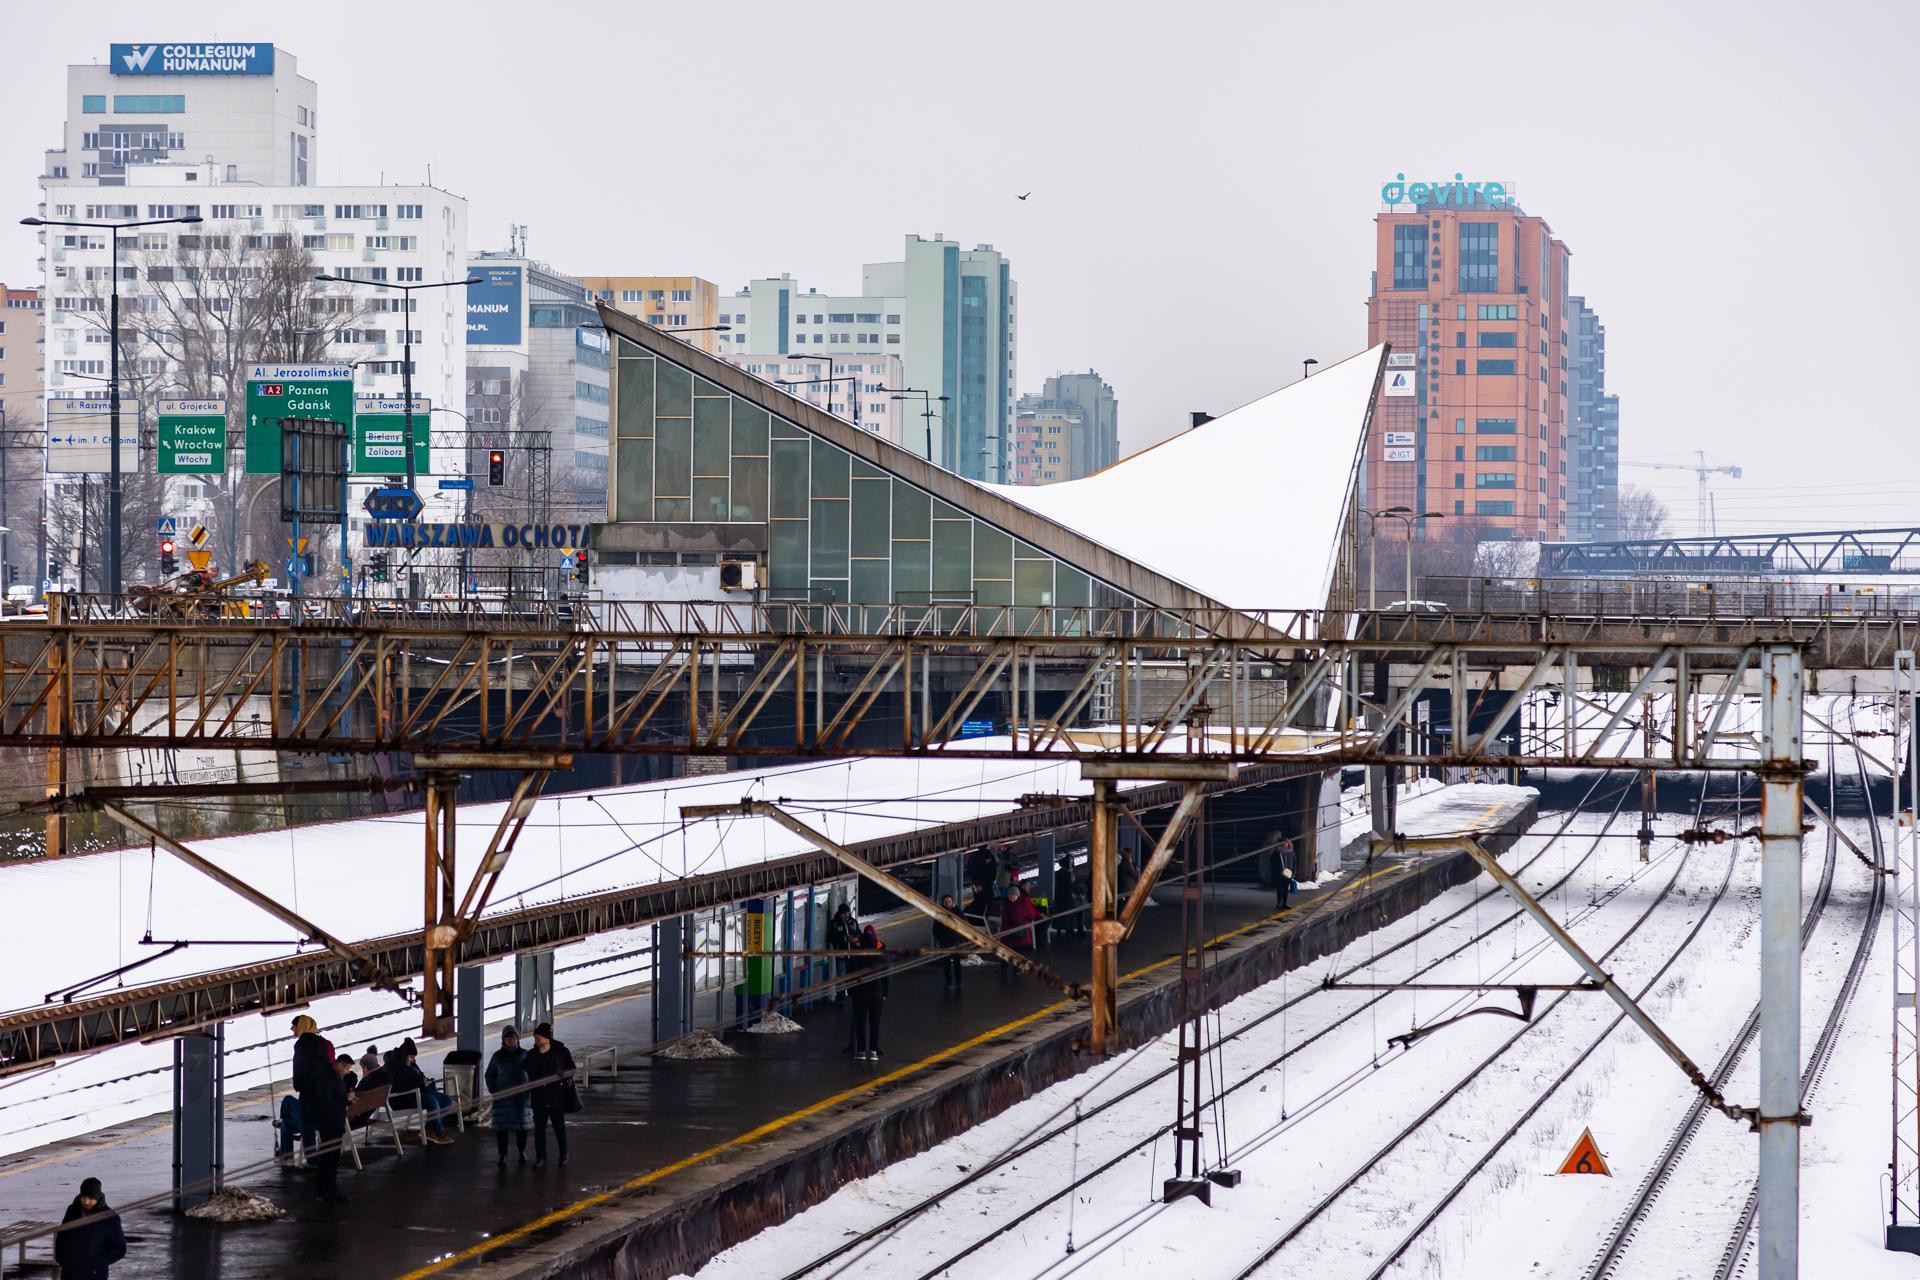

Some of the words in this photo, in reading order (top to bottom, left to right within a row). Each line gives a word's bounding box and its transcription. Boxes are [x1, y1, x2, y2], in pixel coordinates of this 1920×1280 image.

[163, 46, 256, 58] COLLEGIUM
[163, 59, 246, 71] HUMANUM
[467, 304, 509, 313] MANUM
[254, 368, 269, 377] Al.
[273, 368, 350, 377] Jerozolimskie
[288, 384, 329, 395] Poznań
[79, 401, 122, 411] Raszyńs
[287, 399, 331, 410] Gdańsk
[174, 424, 216, 435] Kraków
[78, 436, 89, 444] im.
[102, 436, 137, 446] Chpina
[174, 439, 223, 450] Wrocław
[178, 455, 209, 464] Włochy
[374, 495, 415, 511] PKP
[365, 524, 495, 548] WARSZAWA
[503, 524, 591, 548] OCHOTA
[753, 919, 761, 945] BILETY
[1576, 1151, 1592, 1174] 6
